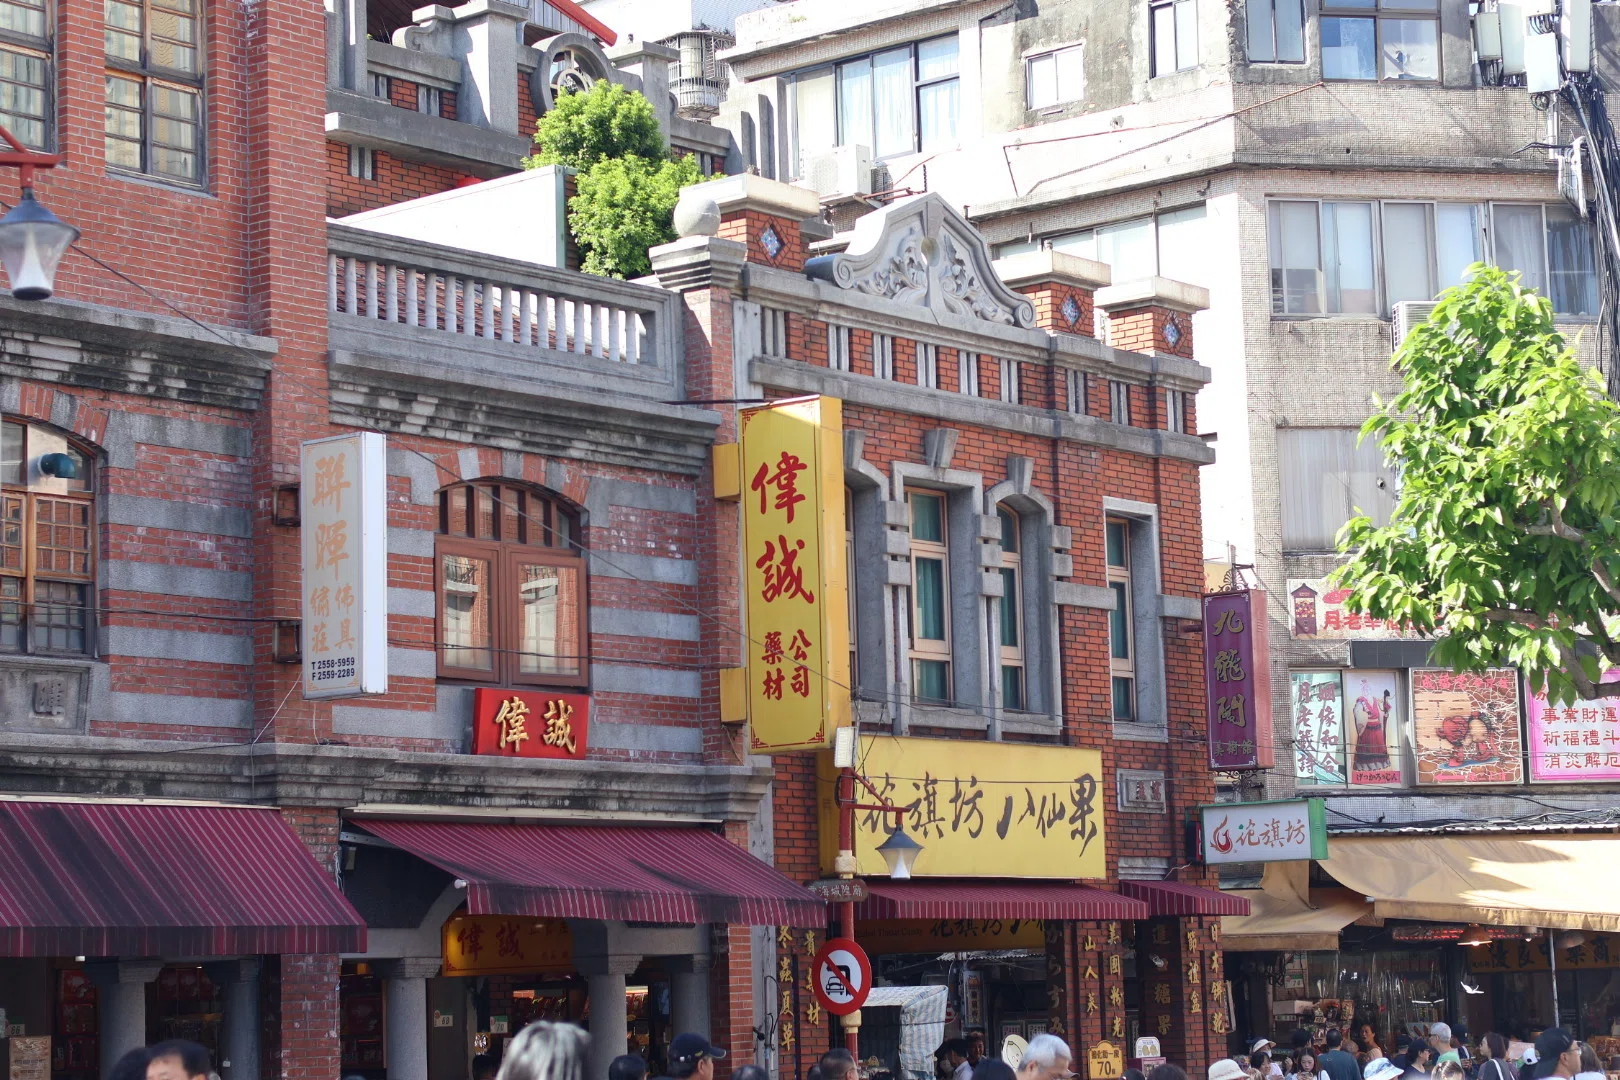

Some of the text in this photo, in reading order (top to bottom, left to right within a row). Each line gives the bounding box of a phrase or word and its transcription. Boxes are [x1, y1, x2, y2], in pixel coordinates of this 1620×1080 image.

[751, 451, 815, 604] 偉誠
[311, 657, 355, 670] T 2558-5959
[311, 668, 355, 681] F 2559-2289
[495, 696, 576, 754] 偉誠
[1317, 683, 1340, 773] 姻緣和合
[1541, 707, 1619, 725] 事業財運
[1543, 729, 1620, 747] 祈福禮斗
[1544, 752, 1620, 769] 消災解厄
[1236, 817, 1307, 848] 花旗坊
[457, 920, 525, 962] 偉誠
